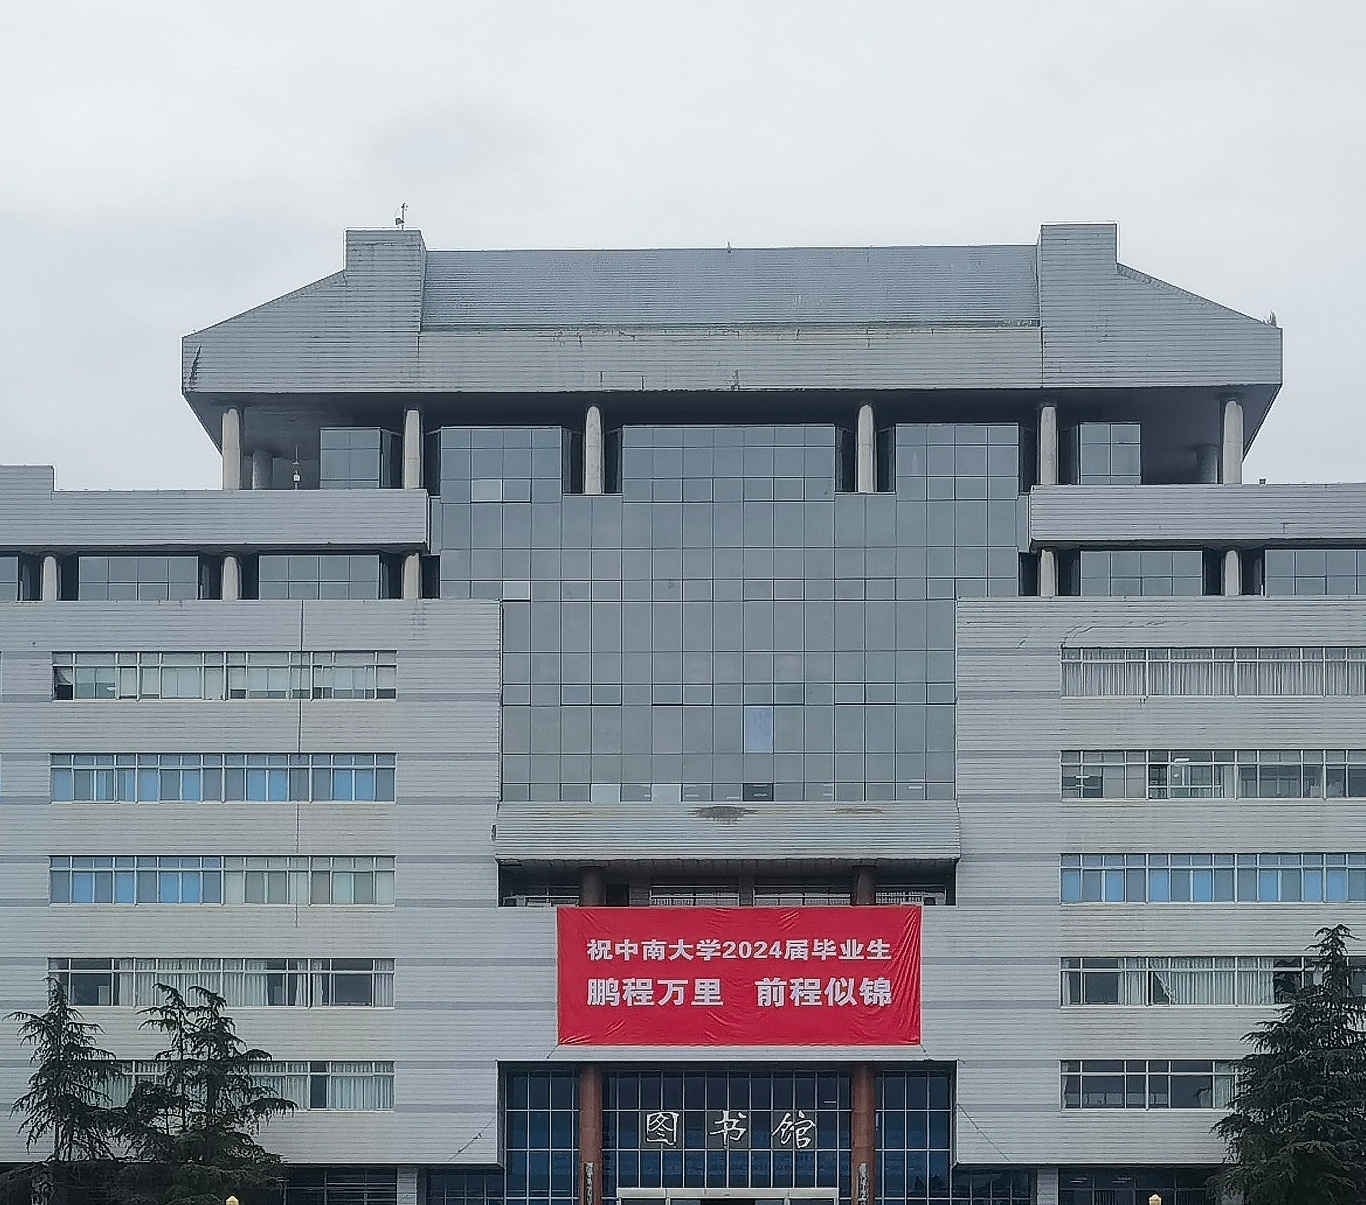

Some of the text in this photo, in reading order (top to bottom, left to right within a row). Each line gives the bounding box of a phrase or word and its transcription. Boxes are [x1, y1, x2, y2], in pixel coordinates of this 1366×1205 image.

[587, 939, 892, 961] 祝中南大学2024届毕业生
[587, 977, 892, 1007] 鹏程万里 前程似锦
[646, 1110, 816, 1148] 图书馆
